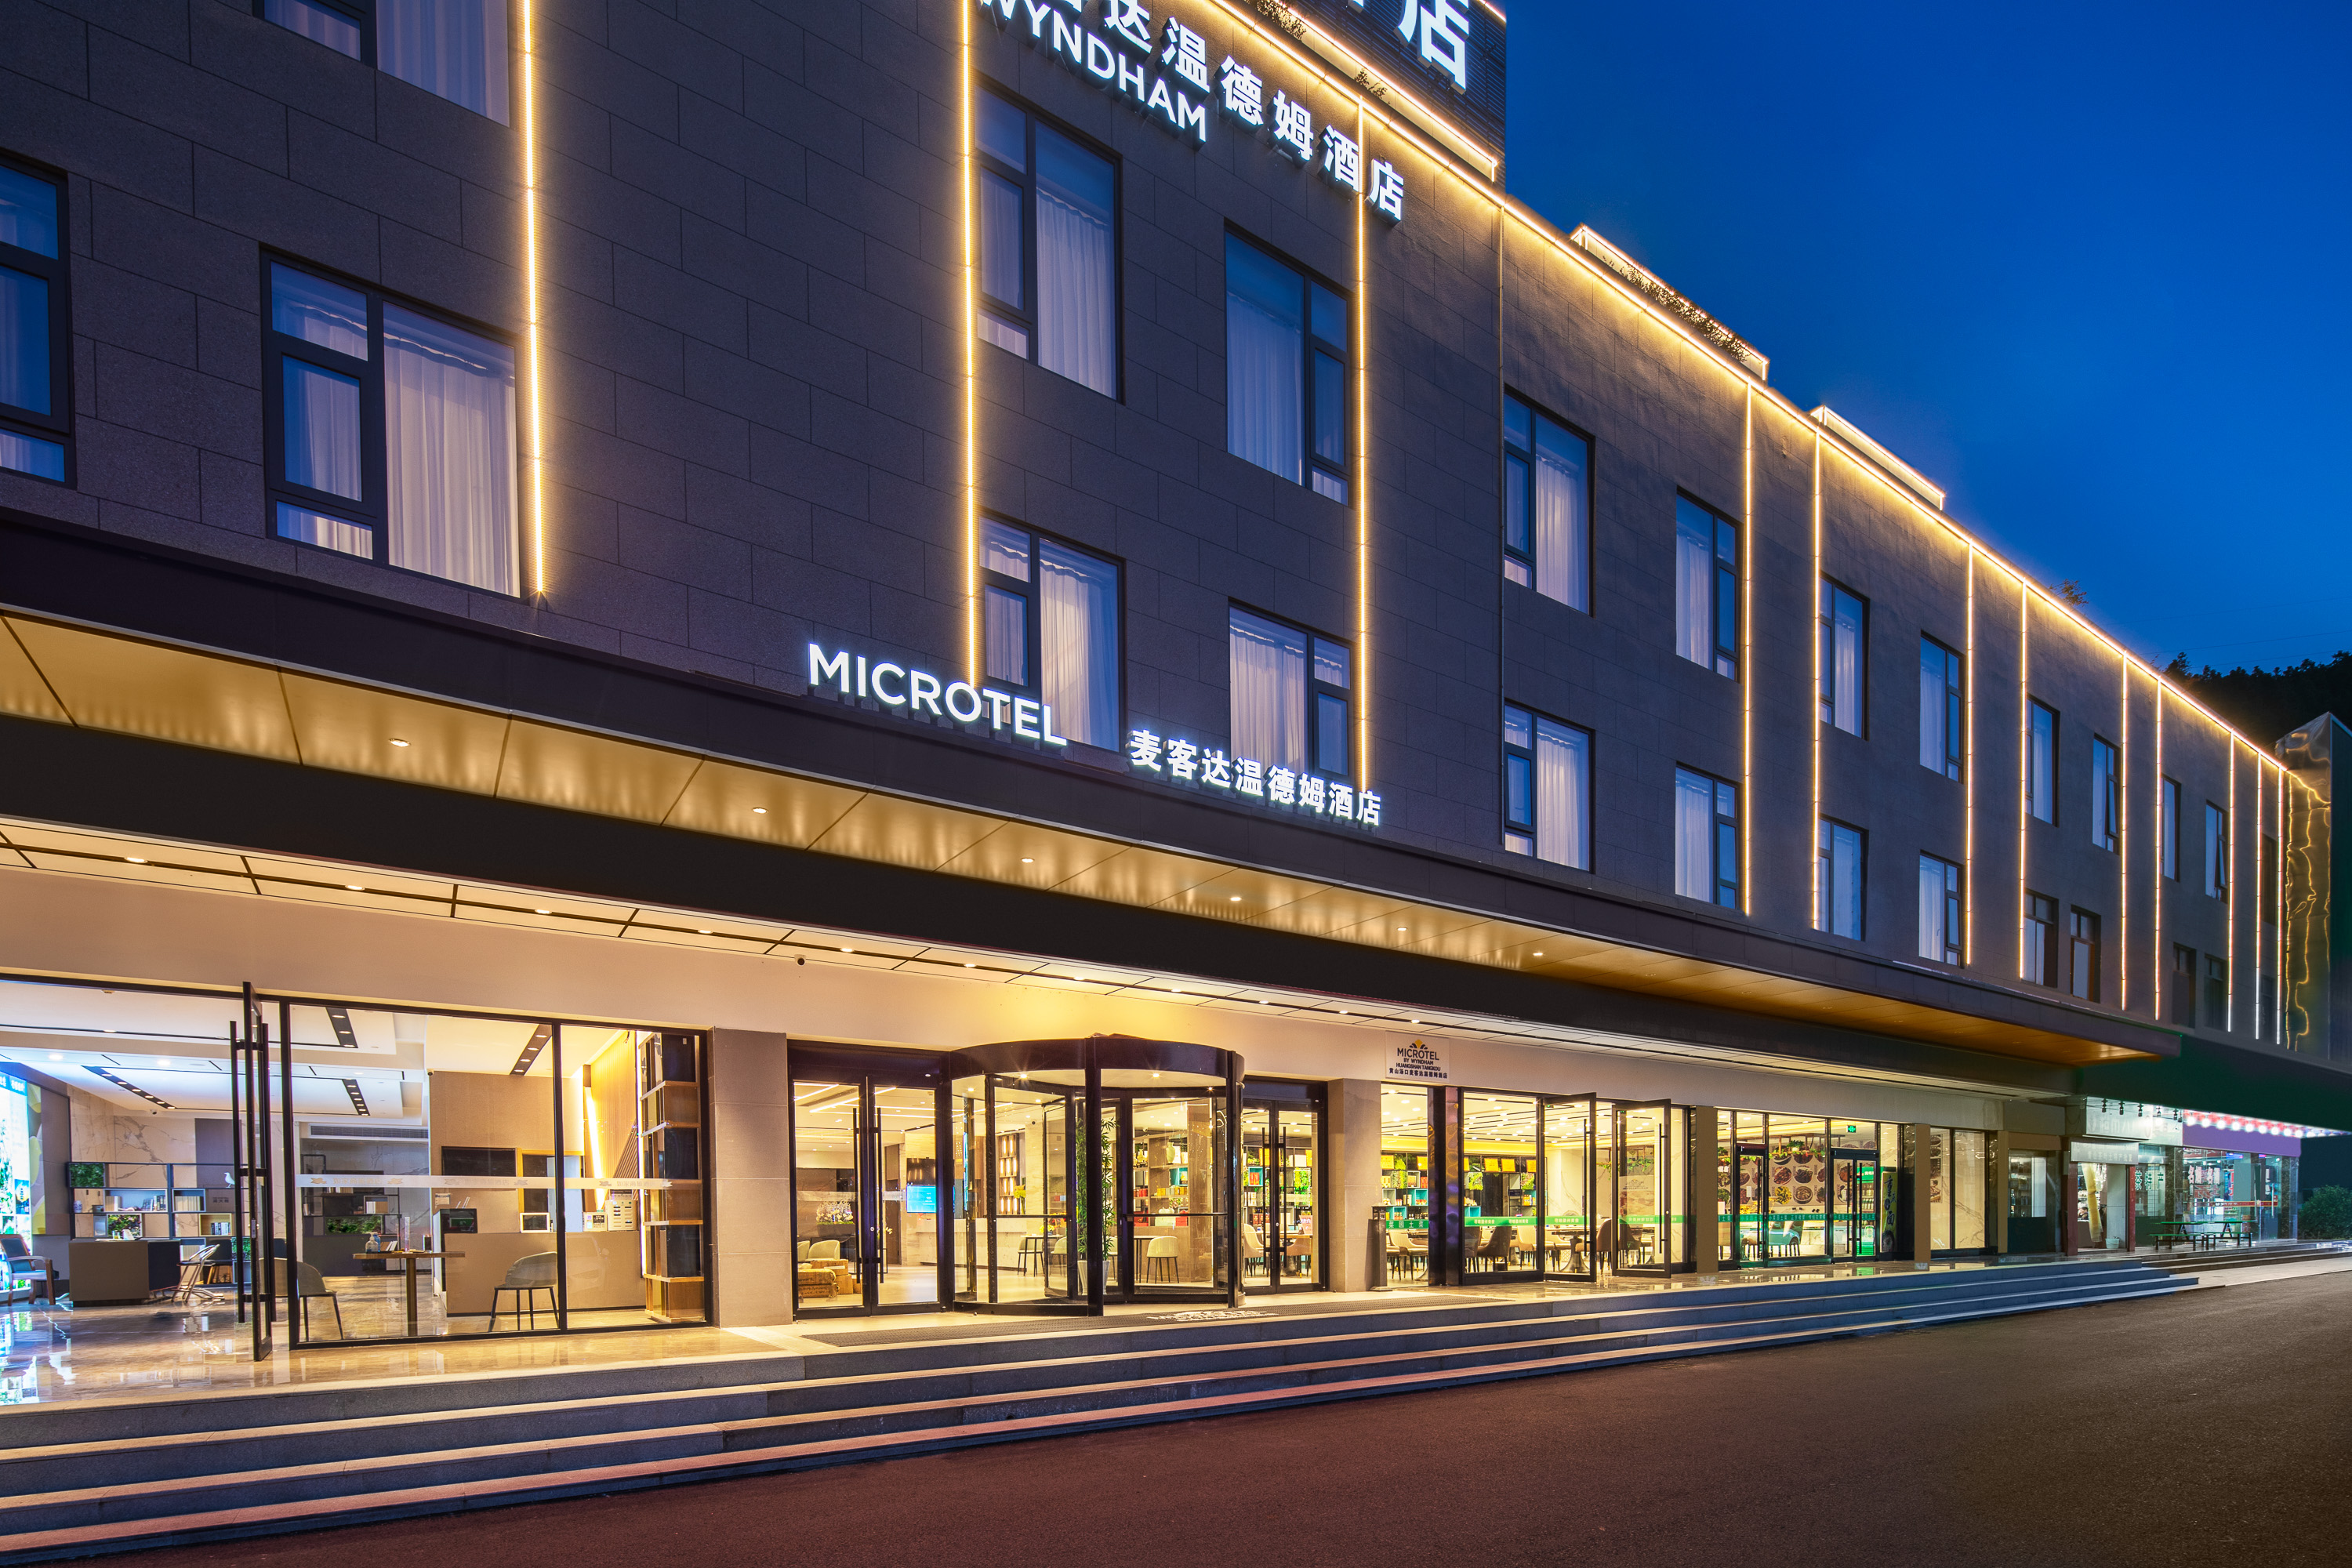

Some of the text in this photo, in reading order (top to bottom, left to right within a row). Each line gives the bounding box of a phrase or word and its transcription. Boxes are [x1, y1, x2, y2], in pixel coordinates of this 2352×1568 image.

[1353, 0, 1470, 90] 店
[1065, 0, 1403, 220] 达温德姆酒店
[808, 643, 1067, 746] MICROTEL
[1130, 729, 1381, 827] 麦客达温德姆酒店
[1397, 1047, 1439, 1060] MICROTEL
